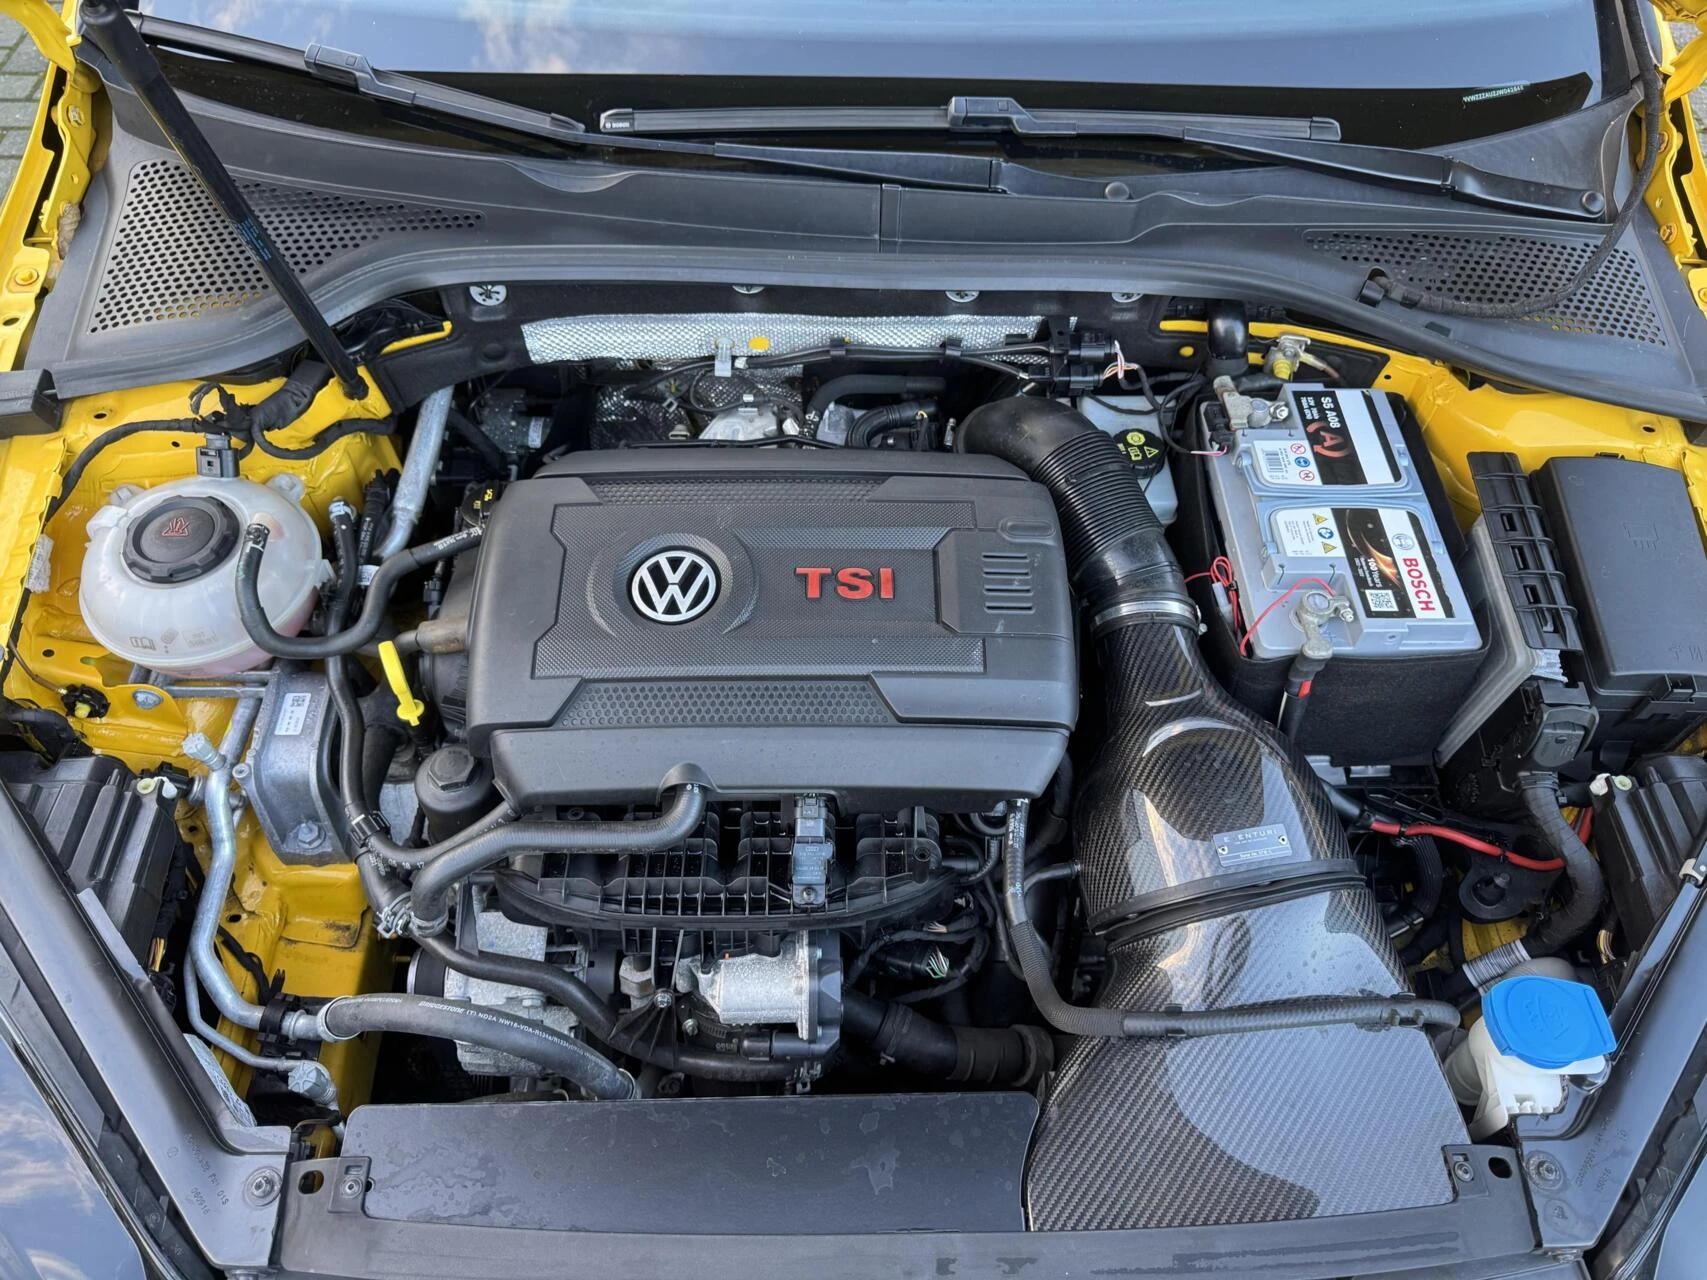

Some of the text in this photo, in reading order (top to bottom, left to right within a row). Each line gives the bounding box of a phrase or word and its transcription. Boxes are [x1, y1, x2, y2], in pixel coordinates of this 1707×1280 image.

[1321, 396, 1341, 429] S5 A08
[631, 550, 717, 622] VW
[795, 567, 894, 599] TSI
[1402, 557, 1437, 612] BOSCH
[418, 1001, 465, 1015] BRIDGESTONE
